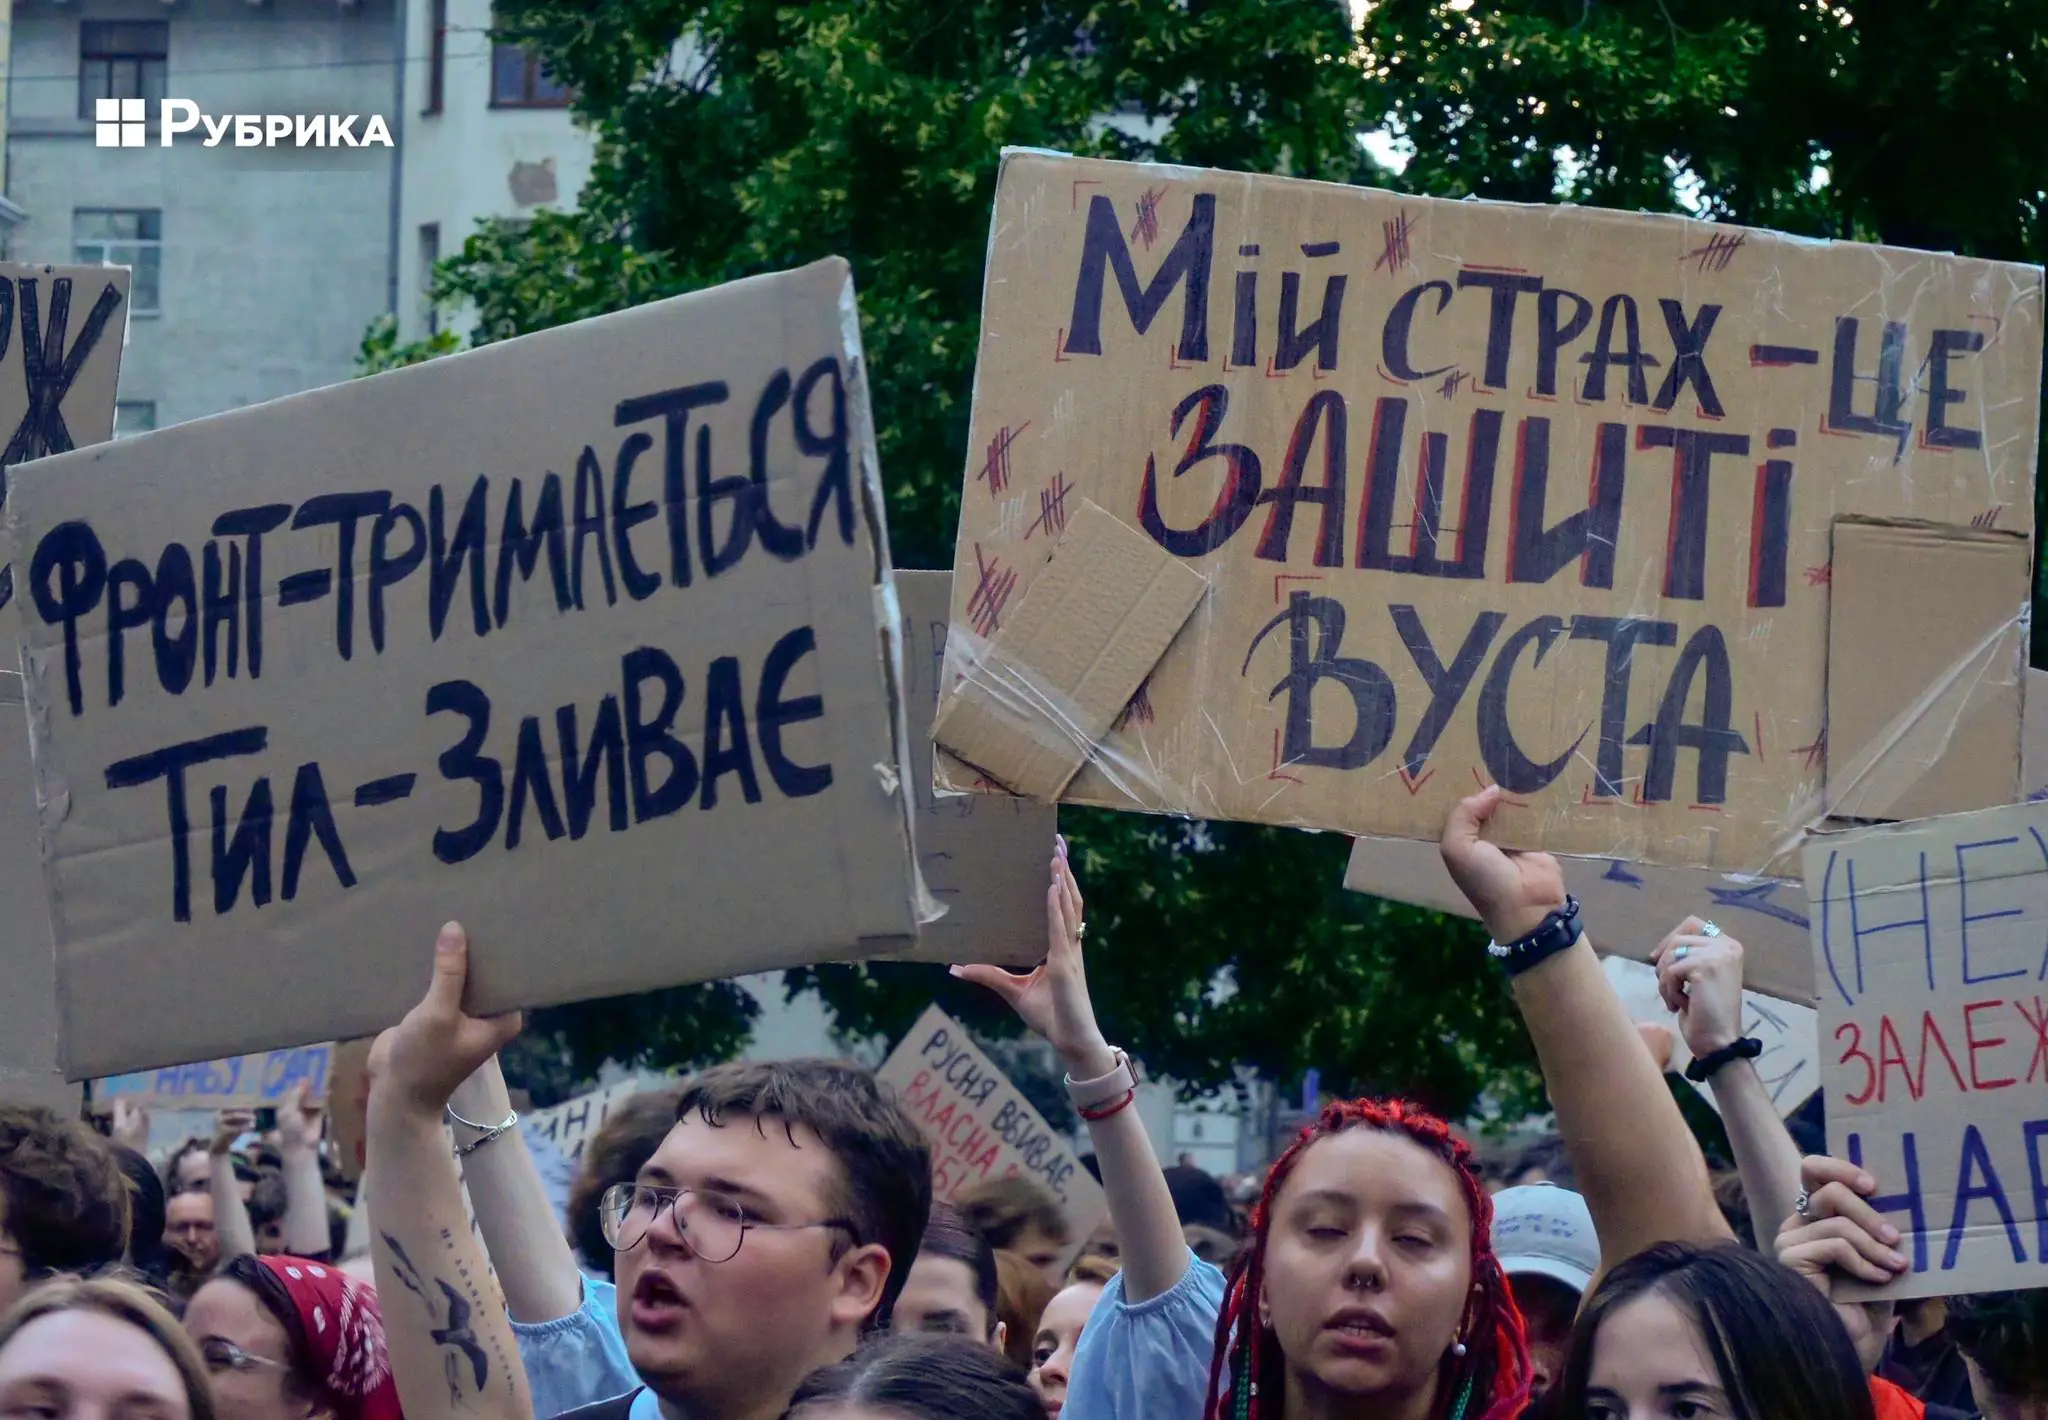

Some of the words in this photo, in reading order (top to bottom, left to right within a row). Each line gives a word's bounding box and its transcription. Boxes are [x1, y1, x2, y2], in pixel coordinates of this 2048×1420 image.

[1381, 266, 1725, 418] СТРАХ
[1241, 588, 1751, 805] ВУСТА
[906, 1070, 1001, 1181] ВЛАСНА
[920, 1028, 998, 1108] РУСНЯ
